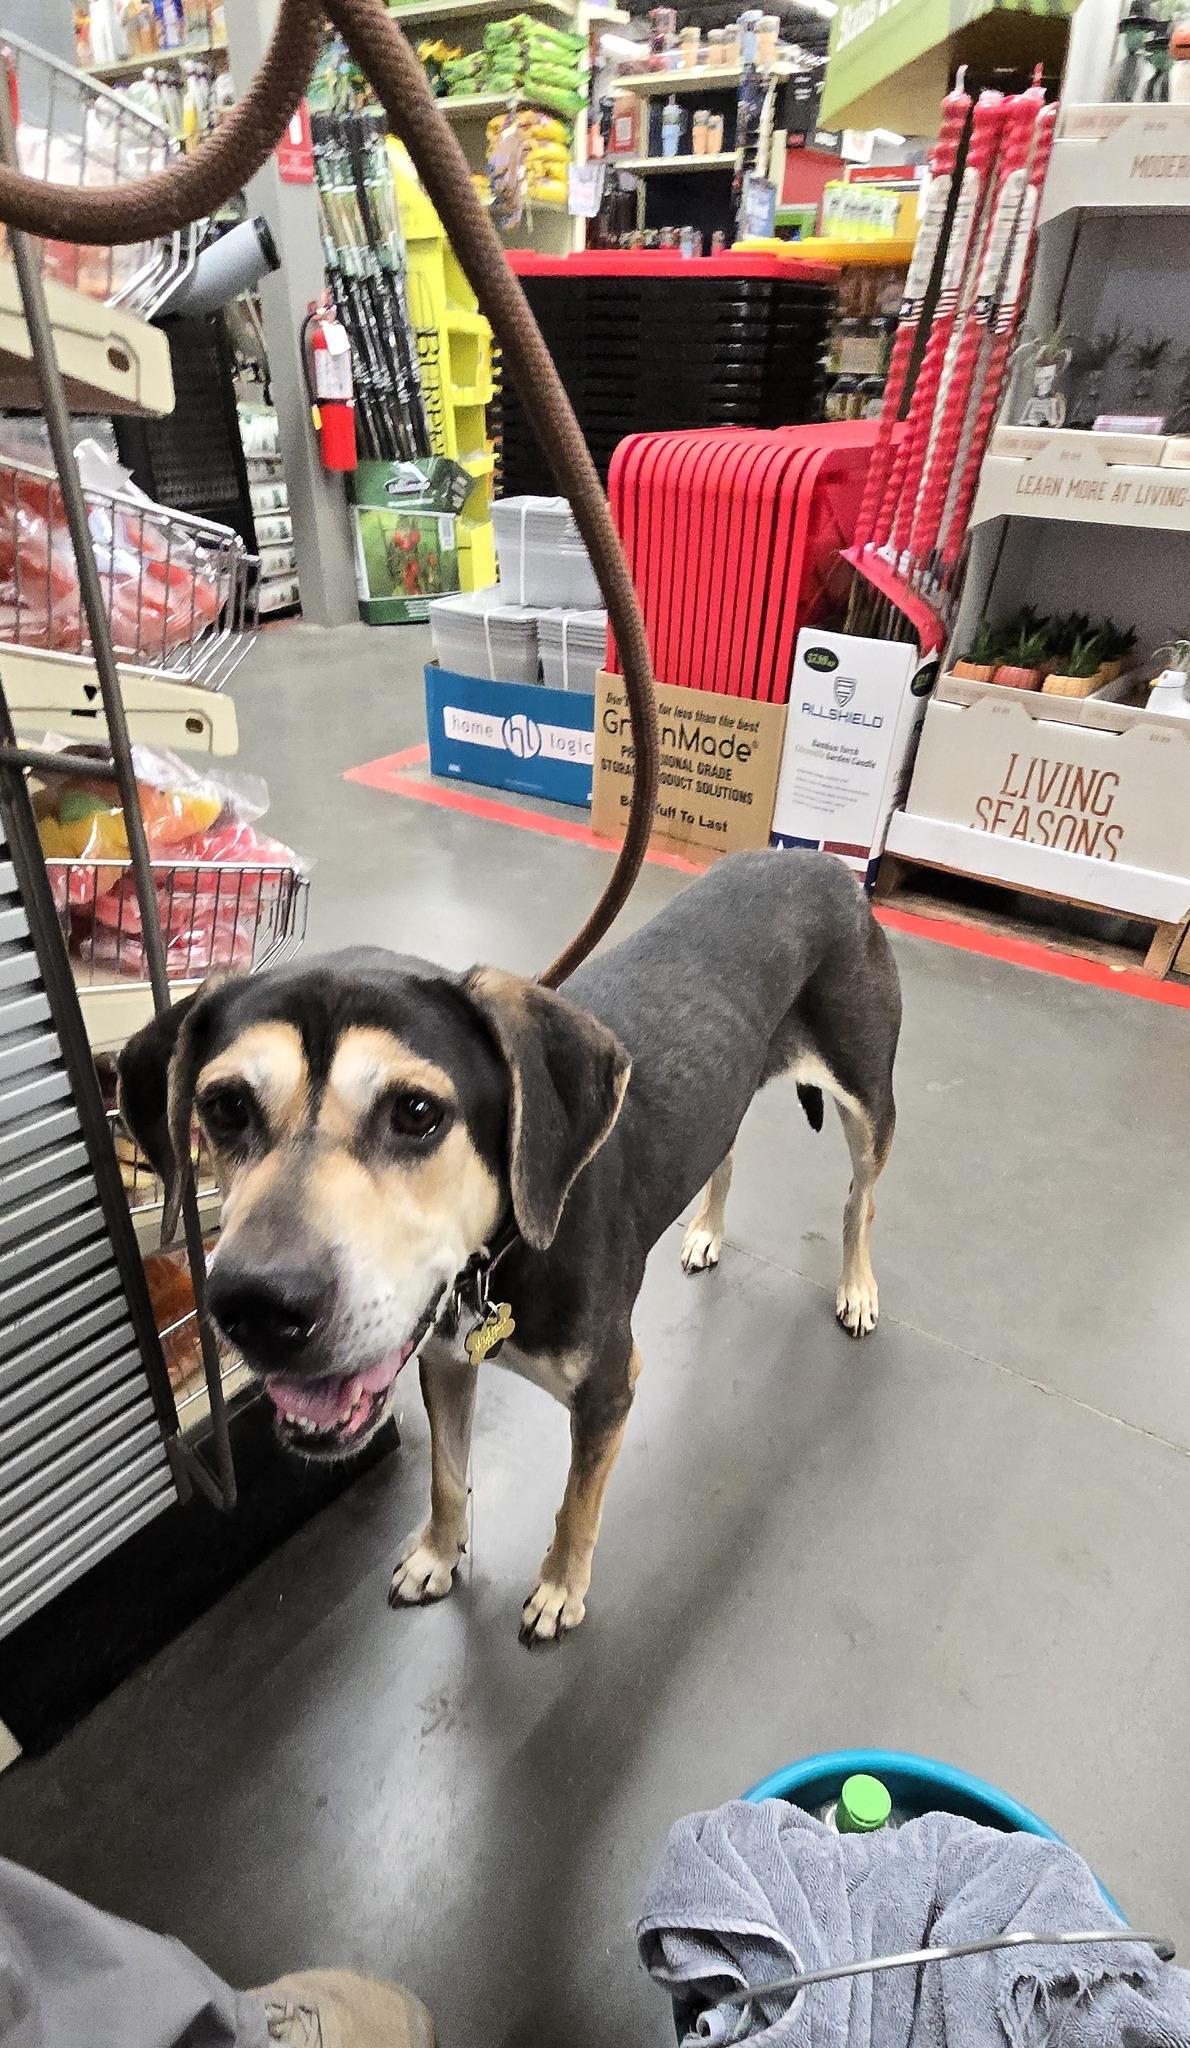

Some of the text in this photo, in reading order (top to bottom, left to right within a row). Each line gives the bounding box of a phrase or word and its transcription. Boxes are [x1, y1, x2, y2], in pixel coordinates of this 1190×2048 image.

[1016, 473, 1064, 497] LEARN
[1066, 479, 1109, 502] MORE
[1111, 482, 1132, 505] AT
[658, 703, 672, 716] for
[674, 705, 693, 720] less
[694, 709, 717, 725] than
[719, 714, 736, 728] the
[737, 718, 760, 733] best
[801, 702, 884, 728] ALLSHIELD
[452, 714, 494, 739] home
[550, 732, 593, 757] logic
[602, 708, 752, 762] GrnMade
[697, 760, 732, 781] GRADE
[999, 752, 1121, 818] LIVING
[696, 780, 753, 805] SOLUTIONS
[680, 809, 695, 824] To
[698, 813, 729, 833] Last
[969, 795, 1125, 862] SEASONS
